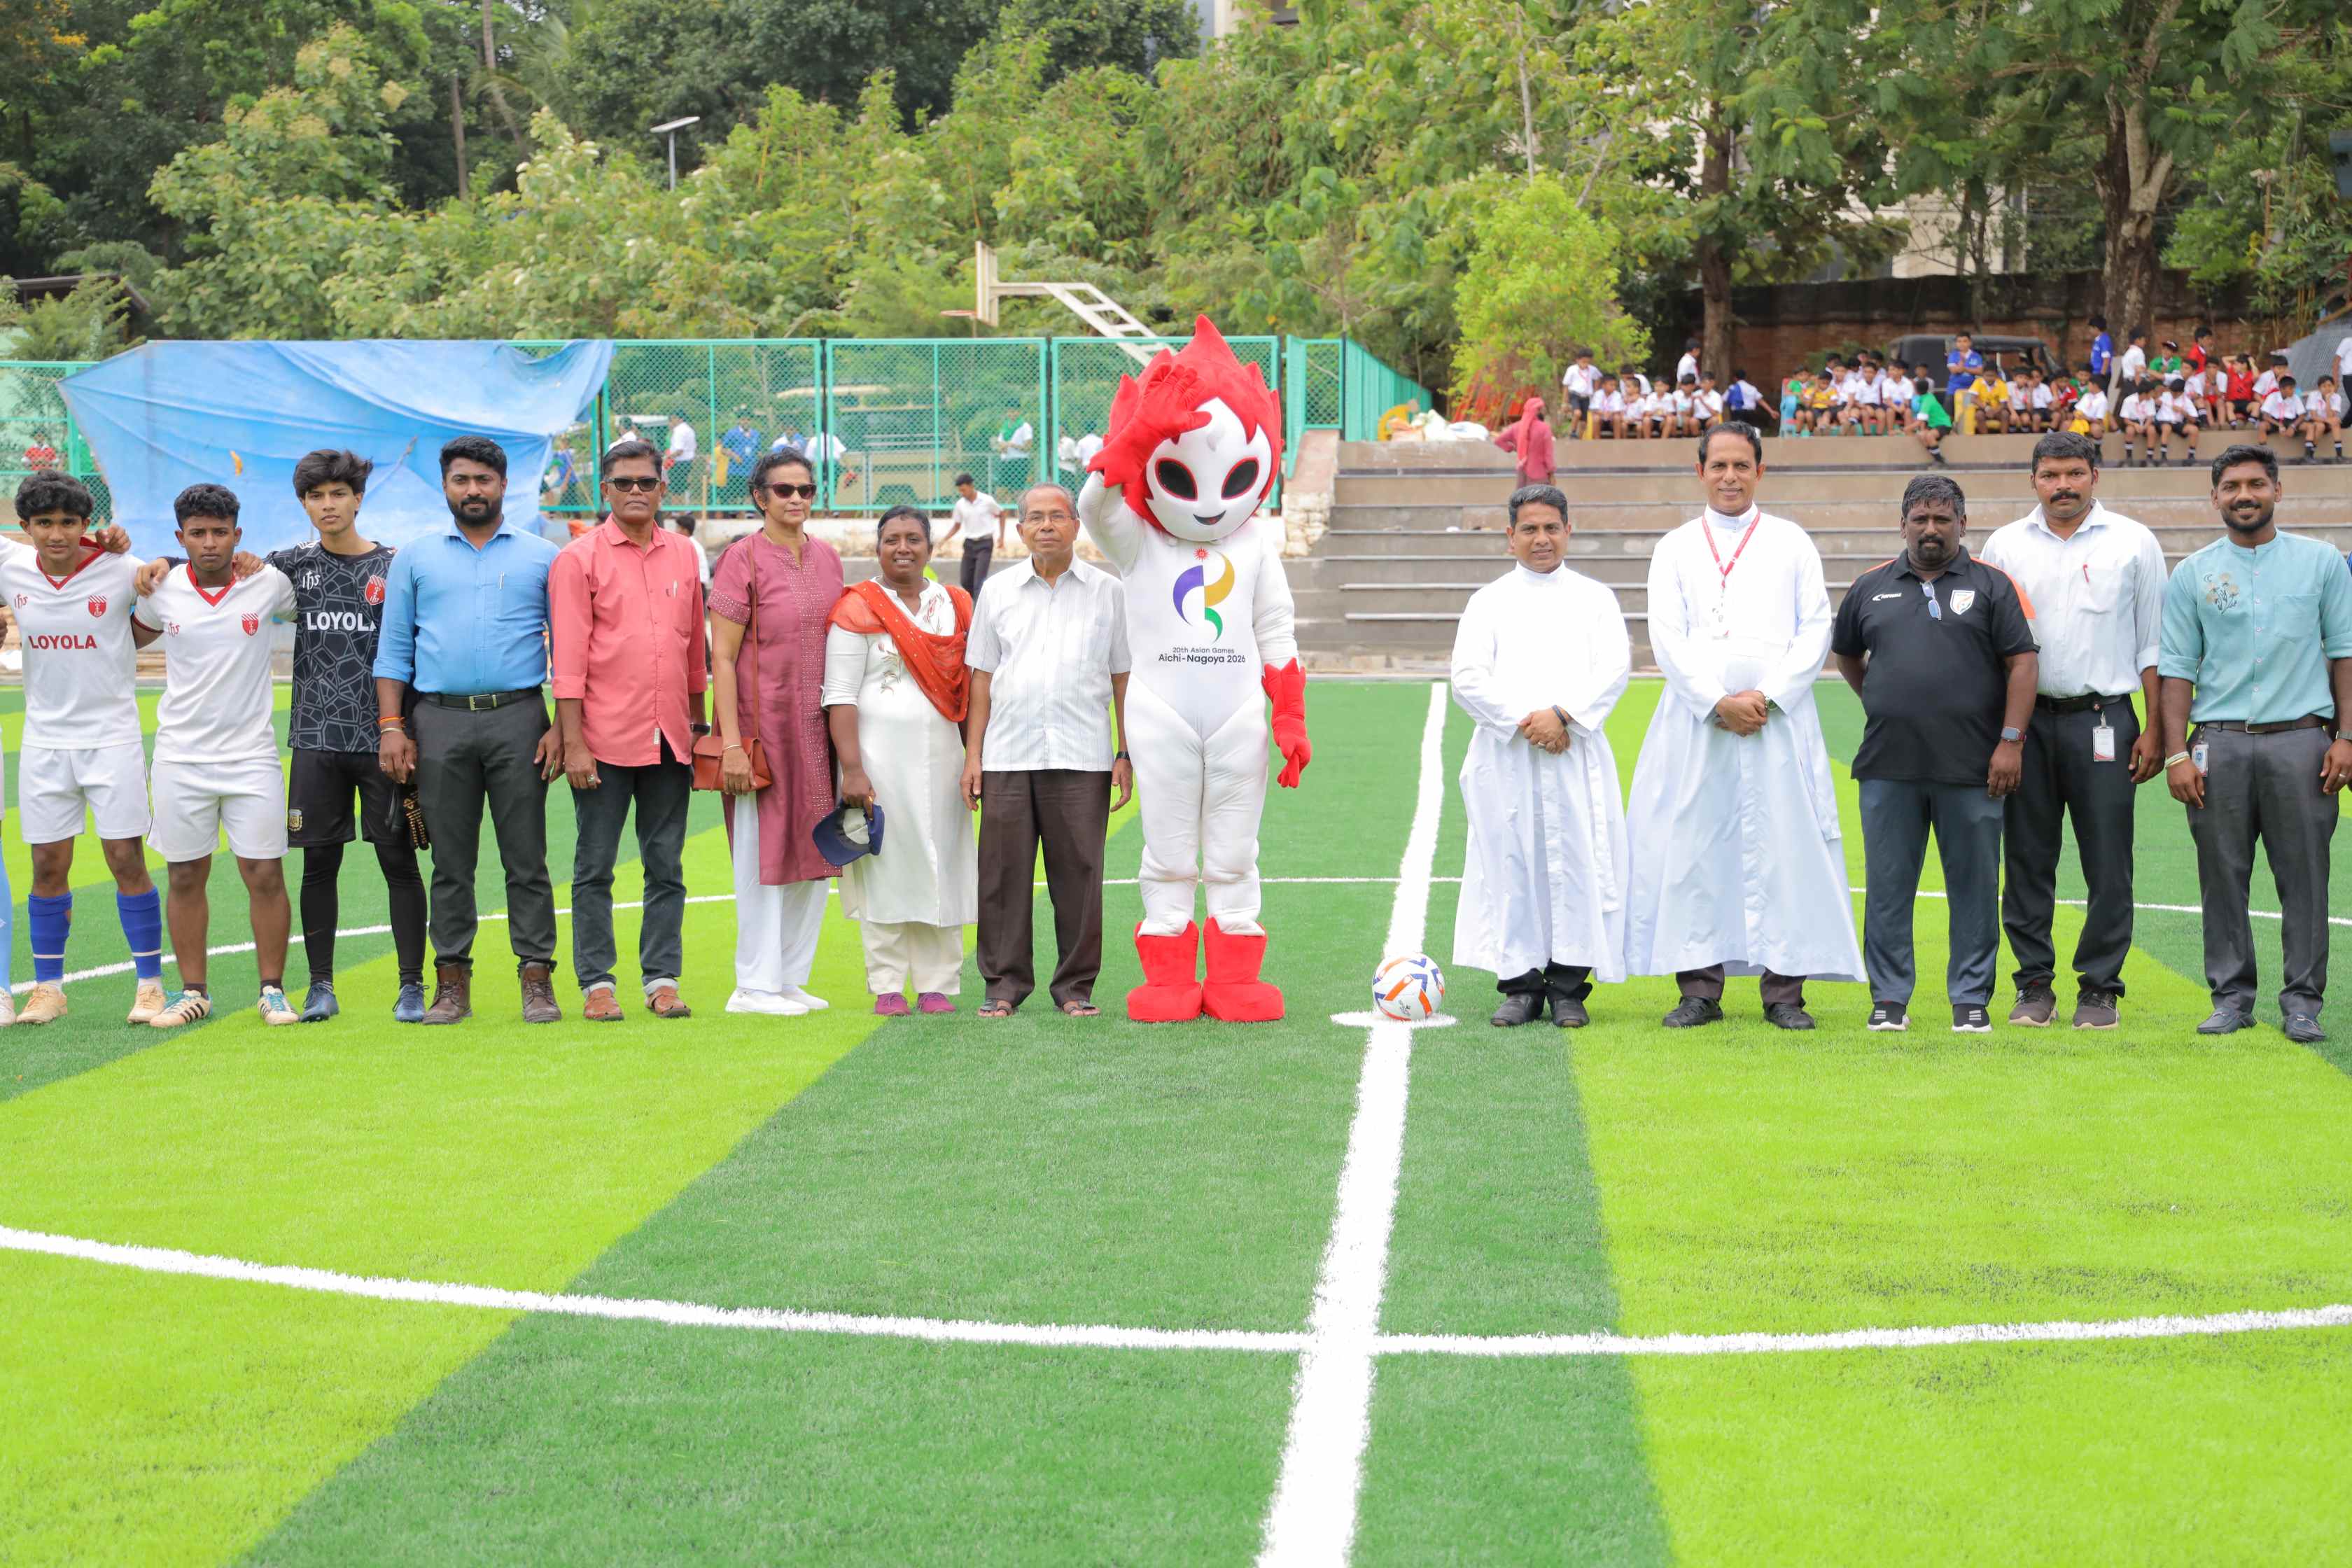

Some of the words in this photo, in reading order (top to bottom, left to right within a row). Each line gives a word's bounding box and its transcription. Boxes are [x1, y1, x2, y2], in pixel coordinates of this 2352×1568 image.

[28, 634, 97, 650] LOYOLA
[1158, 653, 1225, 665] Aichi-Nagoya
[1226, 654, 1246, 663] 2026
